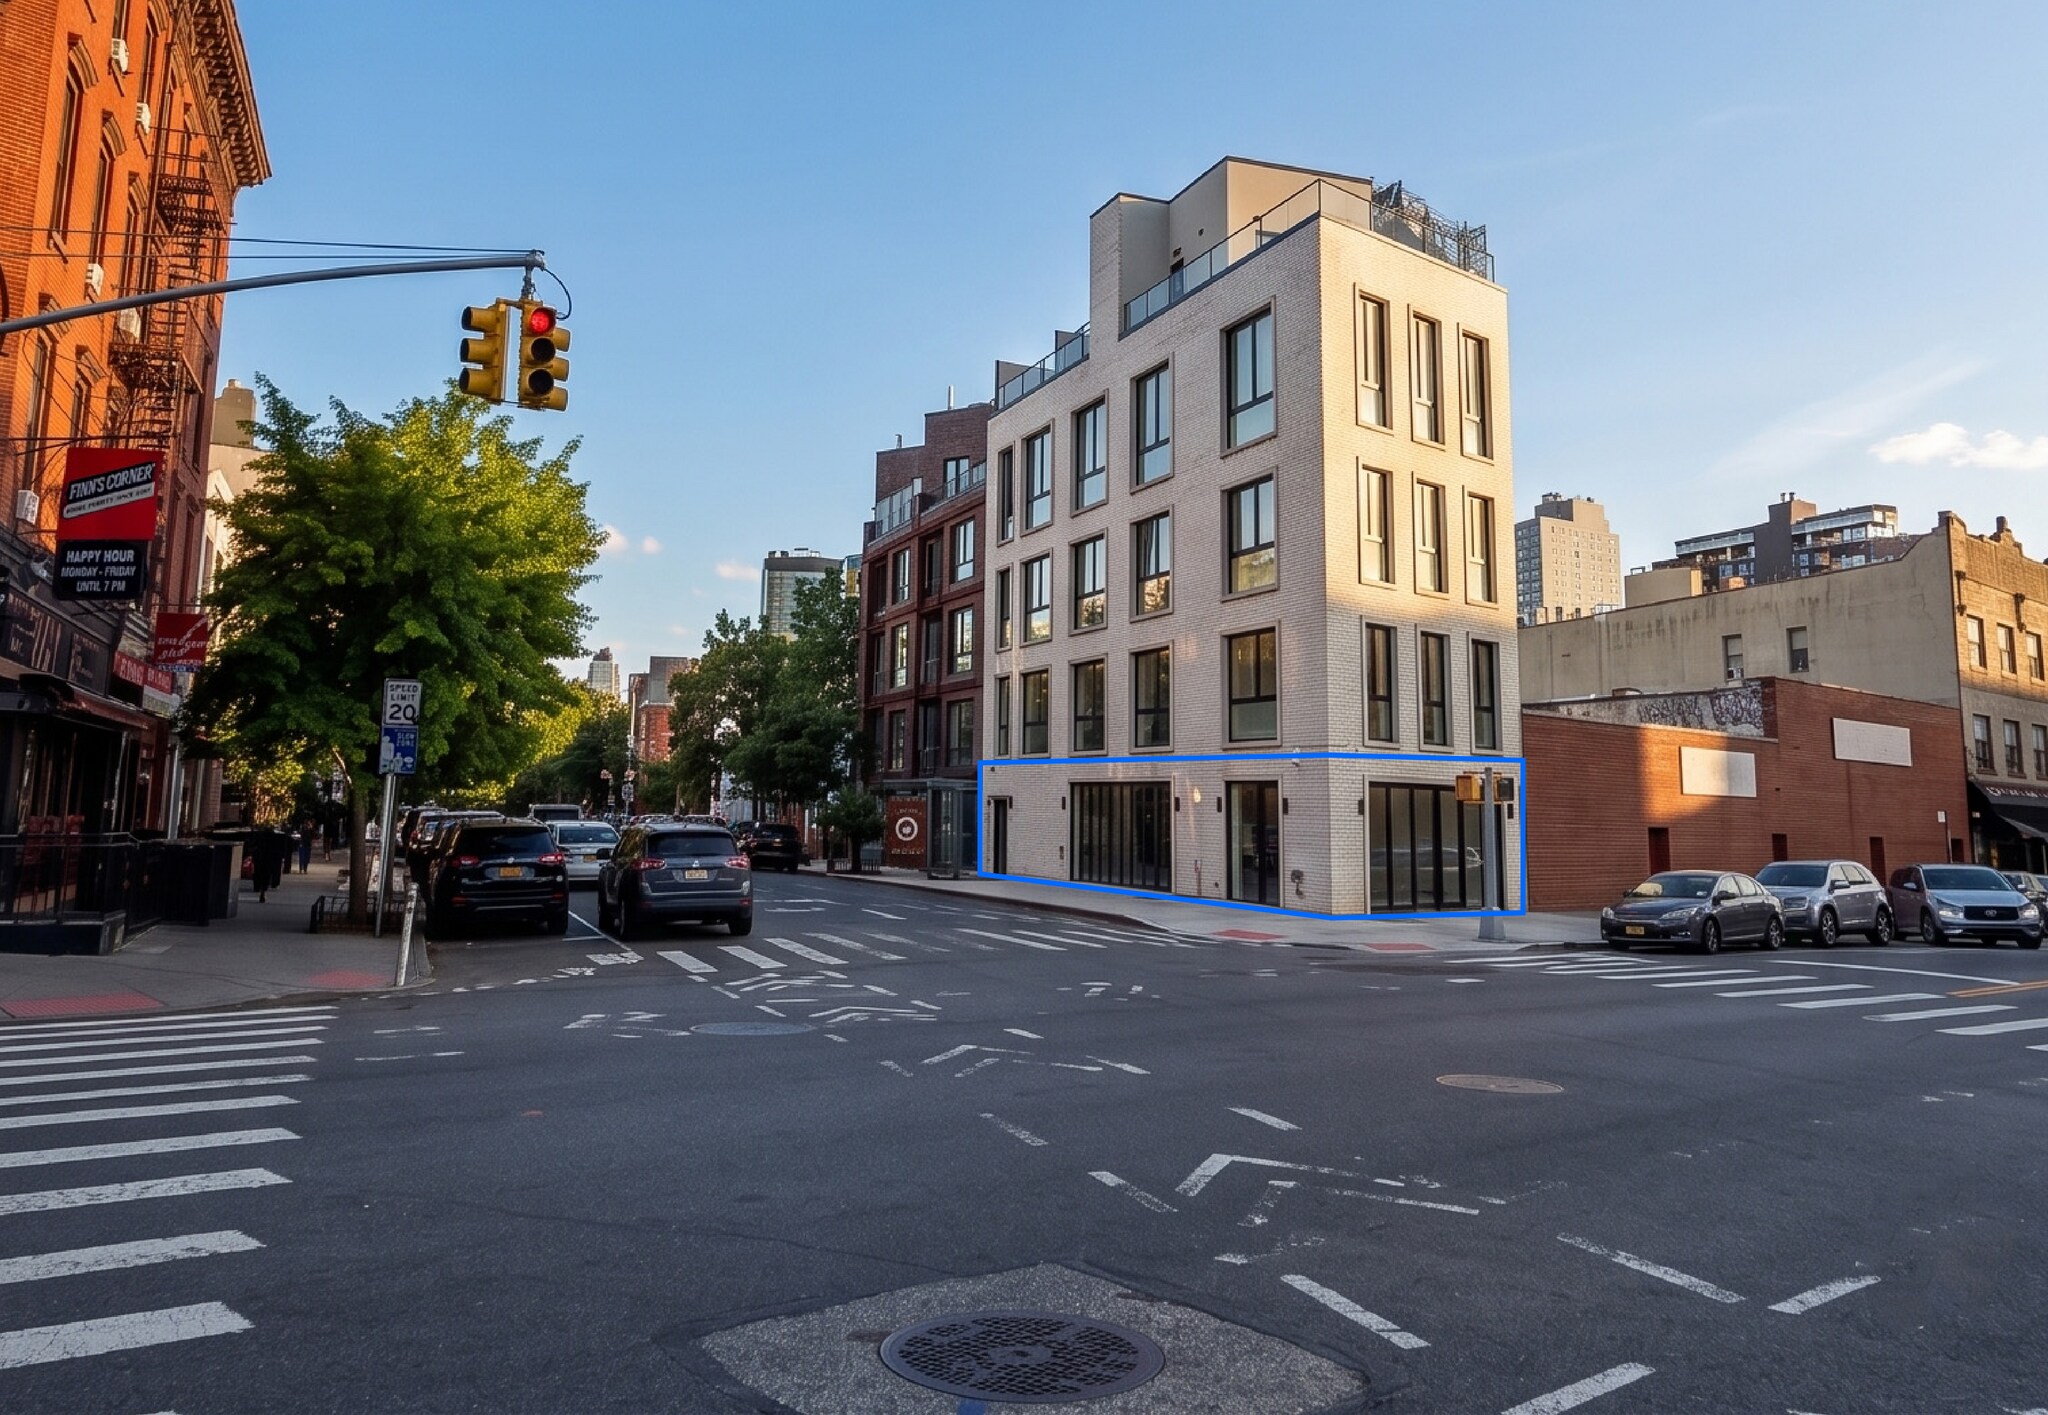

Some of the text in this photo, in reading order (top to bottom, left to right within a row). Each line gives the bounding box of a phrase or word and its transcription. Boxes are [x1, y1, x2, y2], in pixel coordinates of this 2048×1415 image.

[69, 463, 153, 500] FINN'S CORNER
[66, 549, 135, 563] HAPPY HOUR
[61, 566, 99, 577] MONDAY
[104, 565, 137, 577] FRIDAY
[76, 580, 126, 592] UNTIL 7 PM
[389, 684, 418, 693] SPEED
[390, 693, 416, 701] LIMIT
[389, 703, 416, 721] 20
